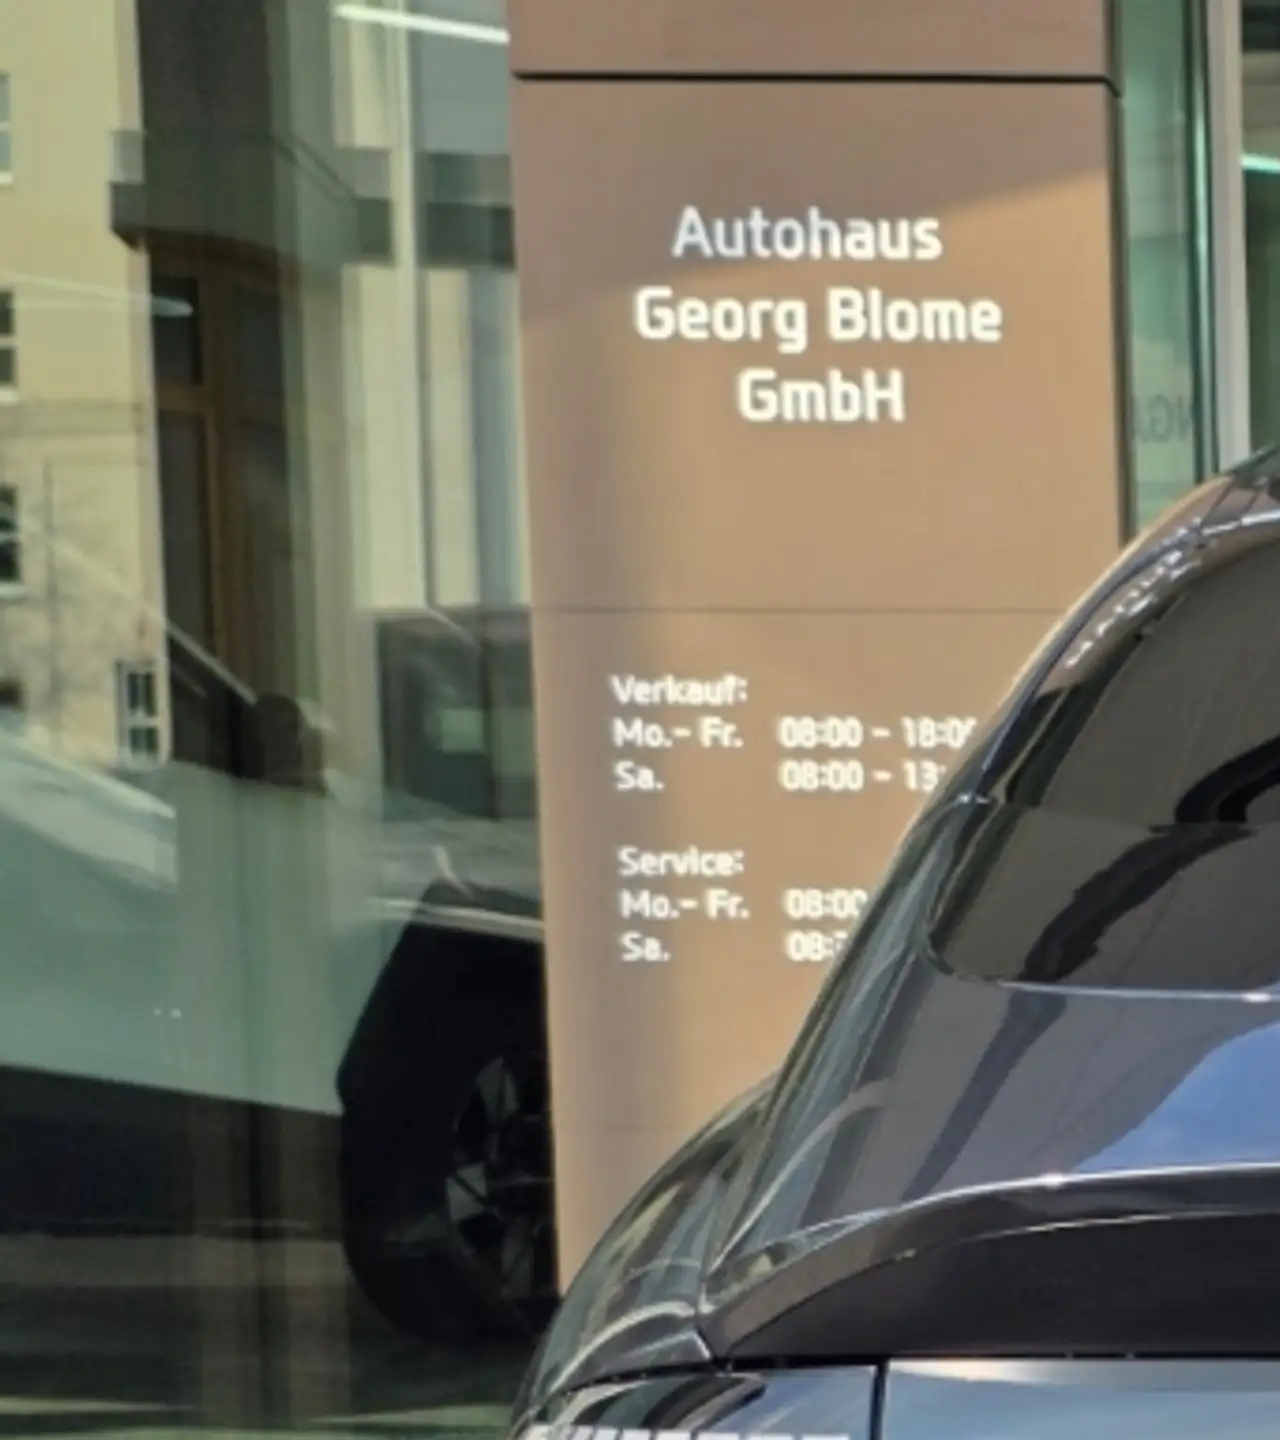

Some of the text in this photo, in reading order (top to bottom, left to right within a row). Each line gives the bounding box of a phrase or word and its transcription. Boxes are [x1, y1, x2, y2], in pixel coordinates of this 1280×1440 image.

[673, 206, 944, 261] Autohaus
[634, 286, 1003, 354] Georg Blome
[737, 367, 905, 422] GmbH
[612, 674, 748, 705] Verkauf:
[699, 715, 744, 748] Fr.
[779, 716, 863, 748] 08:00
[614, 760, 665, 791] Sa.
[781, 760, 864, 791] 08:00
[618, 845, 745, 877] Service:
[705, 887, 750, 919] Fr.
[621, 930, 671, 962] Sa.
